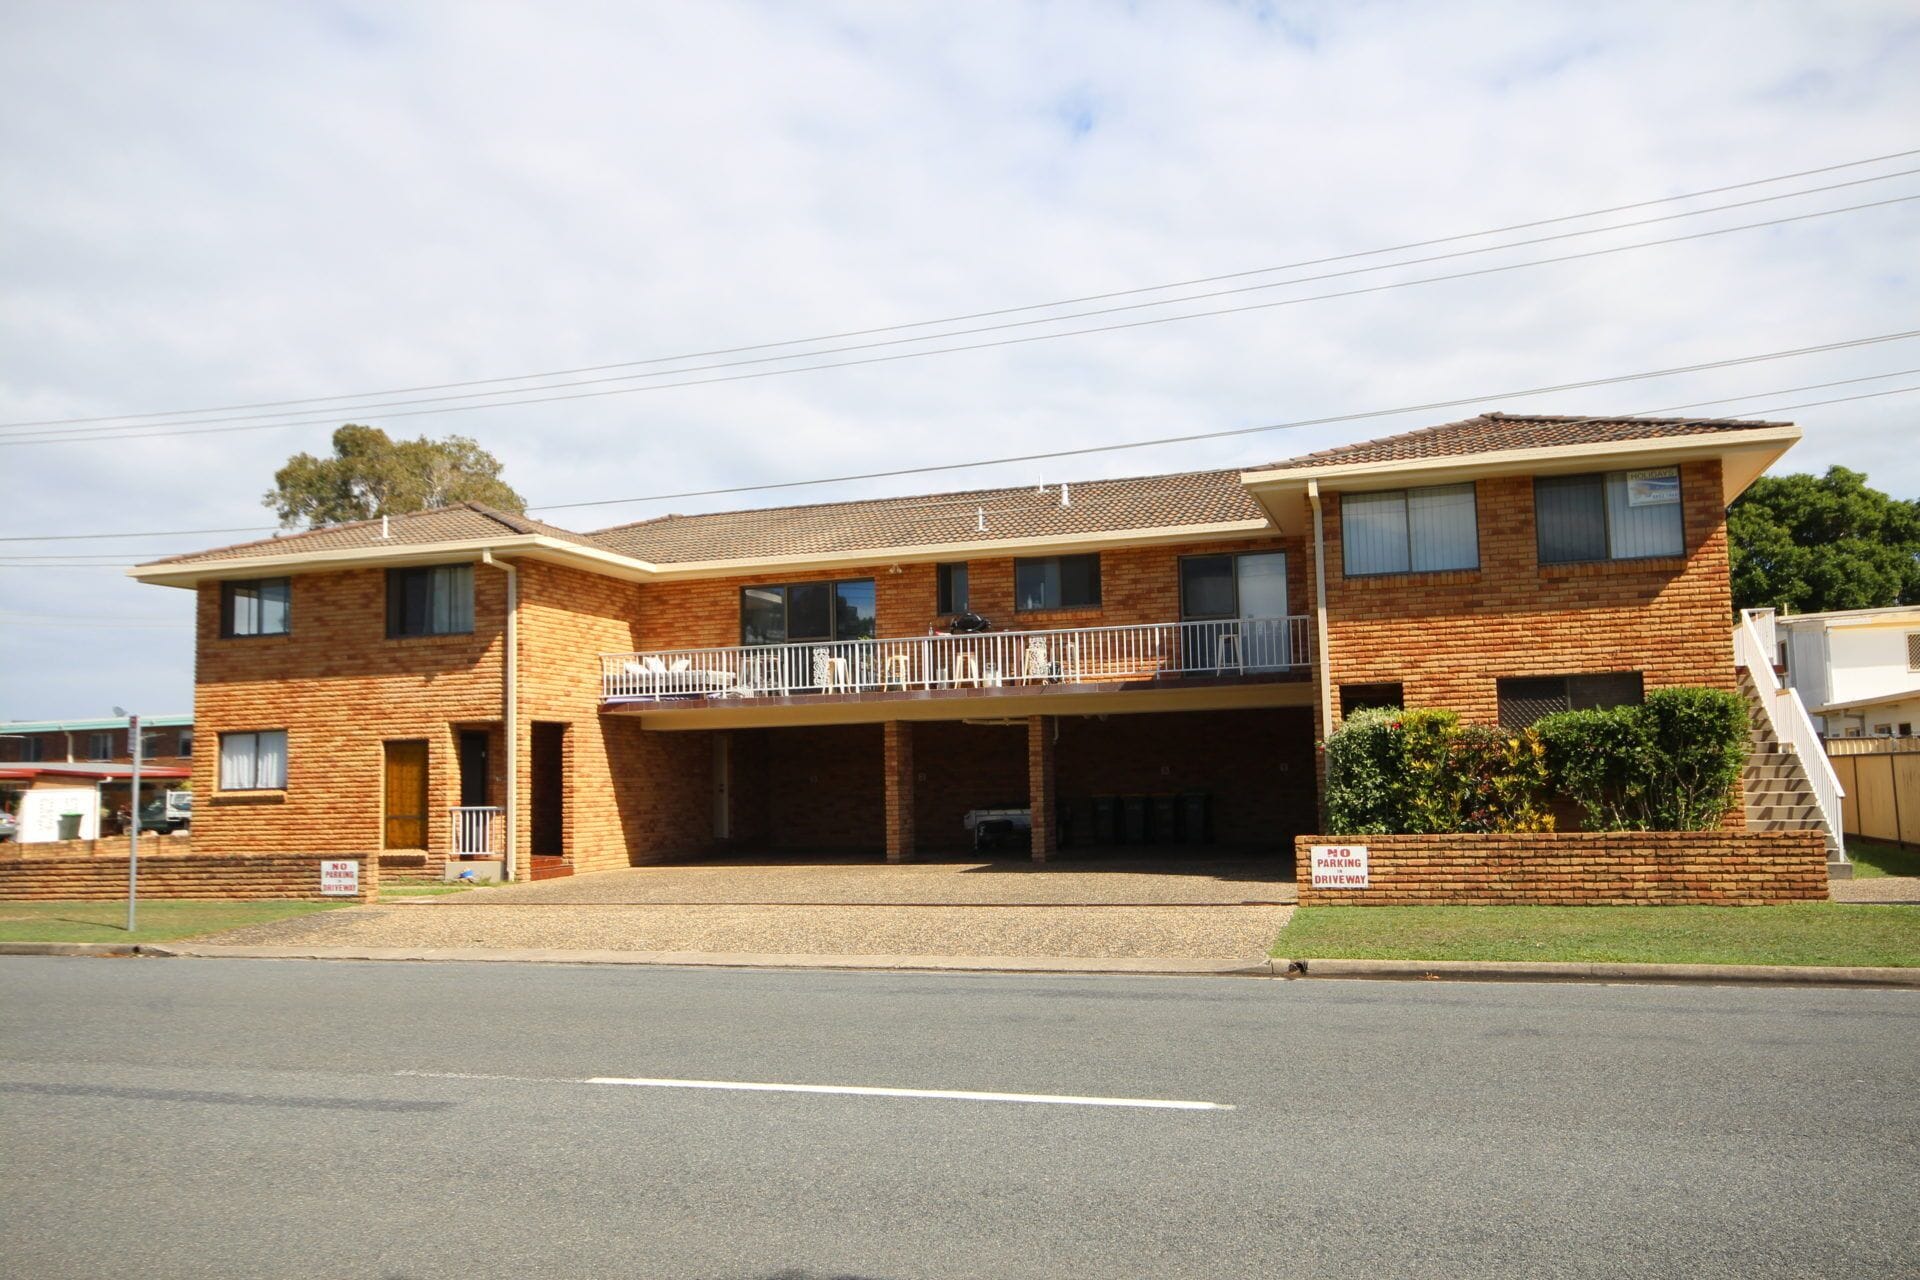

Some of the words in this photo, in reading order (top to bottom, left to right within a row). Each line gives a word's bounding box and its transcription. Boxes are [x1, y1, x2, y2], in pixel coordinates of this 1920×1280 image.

[1327, 848, 1351, 858] NO
[1317, 858, 1361, 868] PARKING
[1314, 875, 1366, 884] DRIVEWAY
